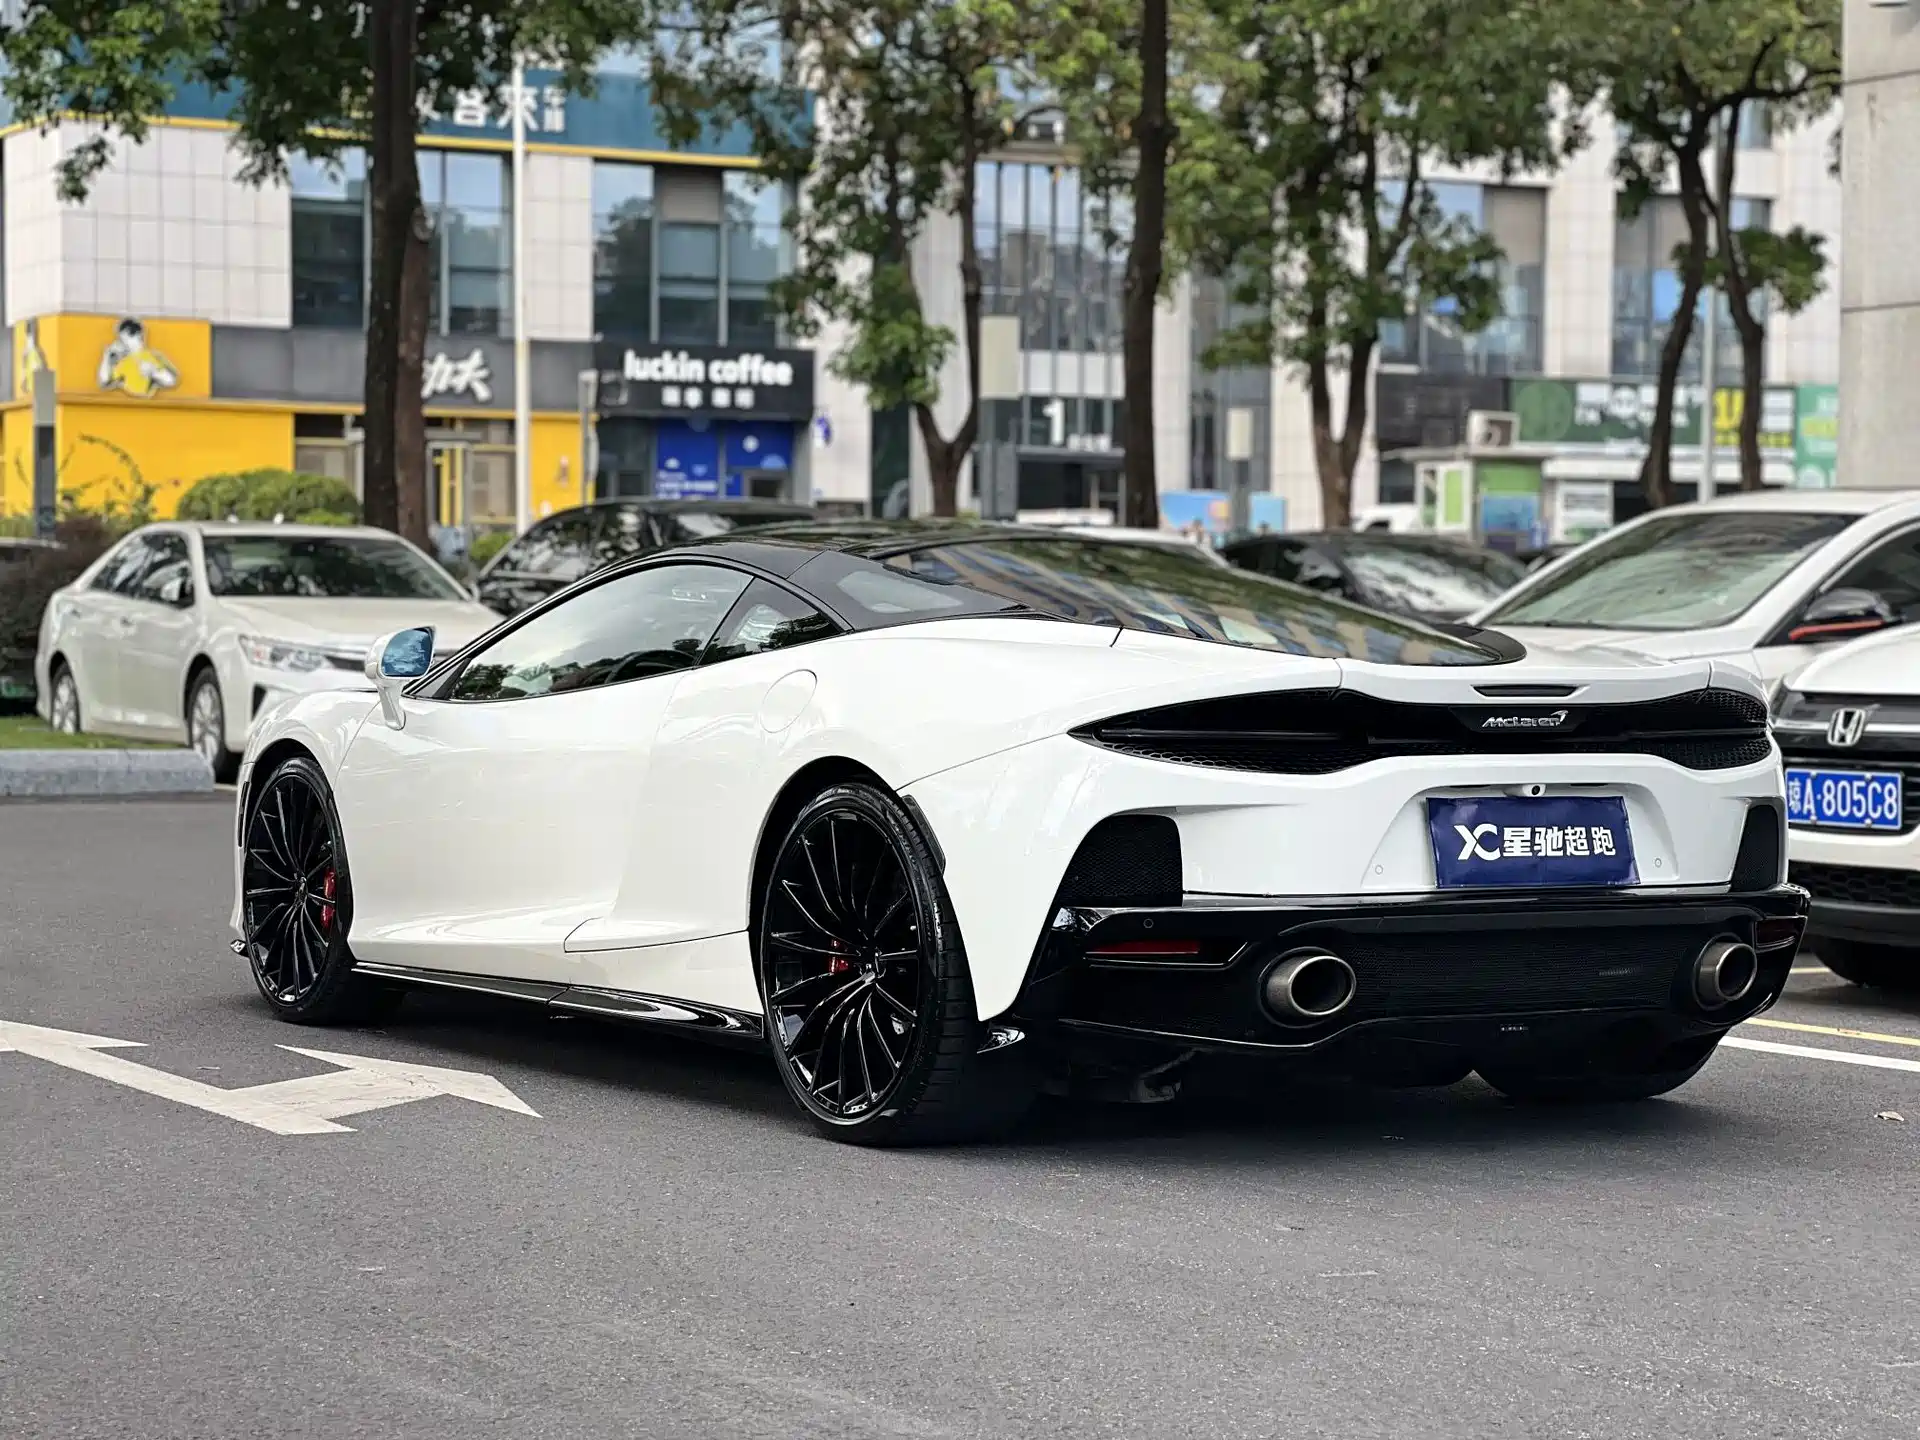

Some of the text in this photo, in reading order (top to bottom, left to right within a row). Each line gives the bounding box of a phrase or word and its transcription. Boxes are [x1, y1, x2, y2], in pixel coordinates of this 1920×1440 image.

[624, 349, 793, 387] luckin coffee
[1482, 716, 1561, 728] McLaren
[1503, 825, 1616, 857] 星驰超跑
